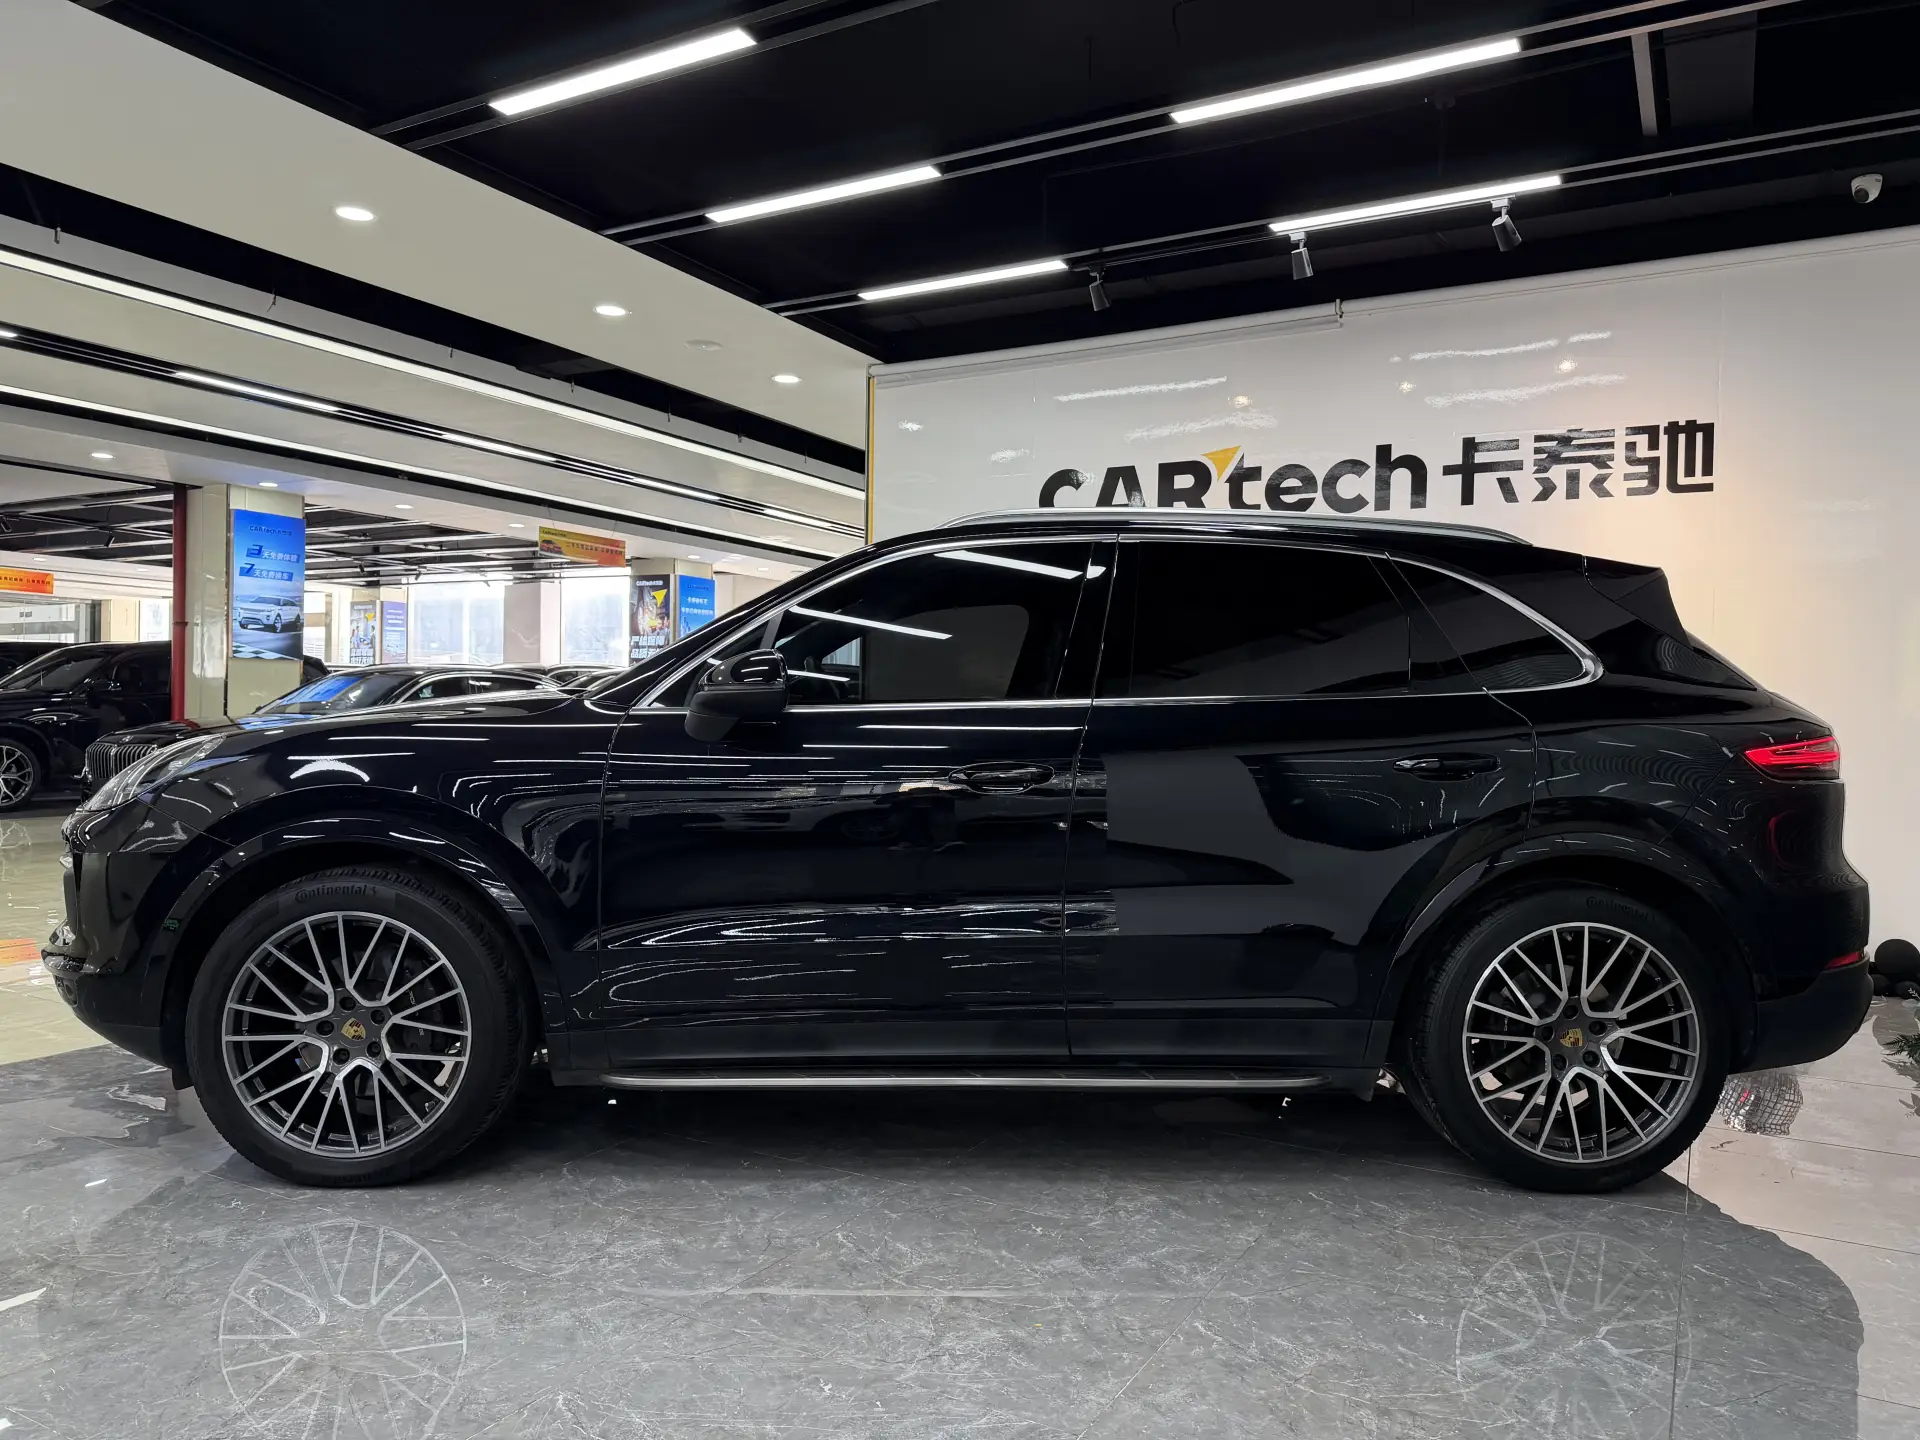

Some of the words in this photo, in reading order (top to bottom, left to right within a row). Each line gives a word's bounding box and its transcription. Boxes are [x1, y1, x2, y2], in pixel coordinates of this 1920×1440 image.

[1039, 443, 1427, 513] CARtech
[1442, 419, 1715, 507] 卡泰驰
[295, 884, 367, 904] Continental
